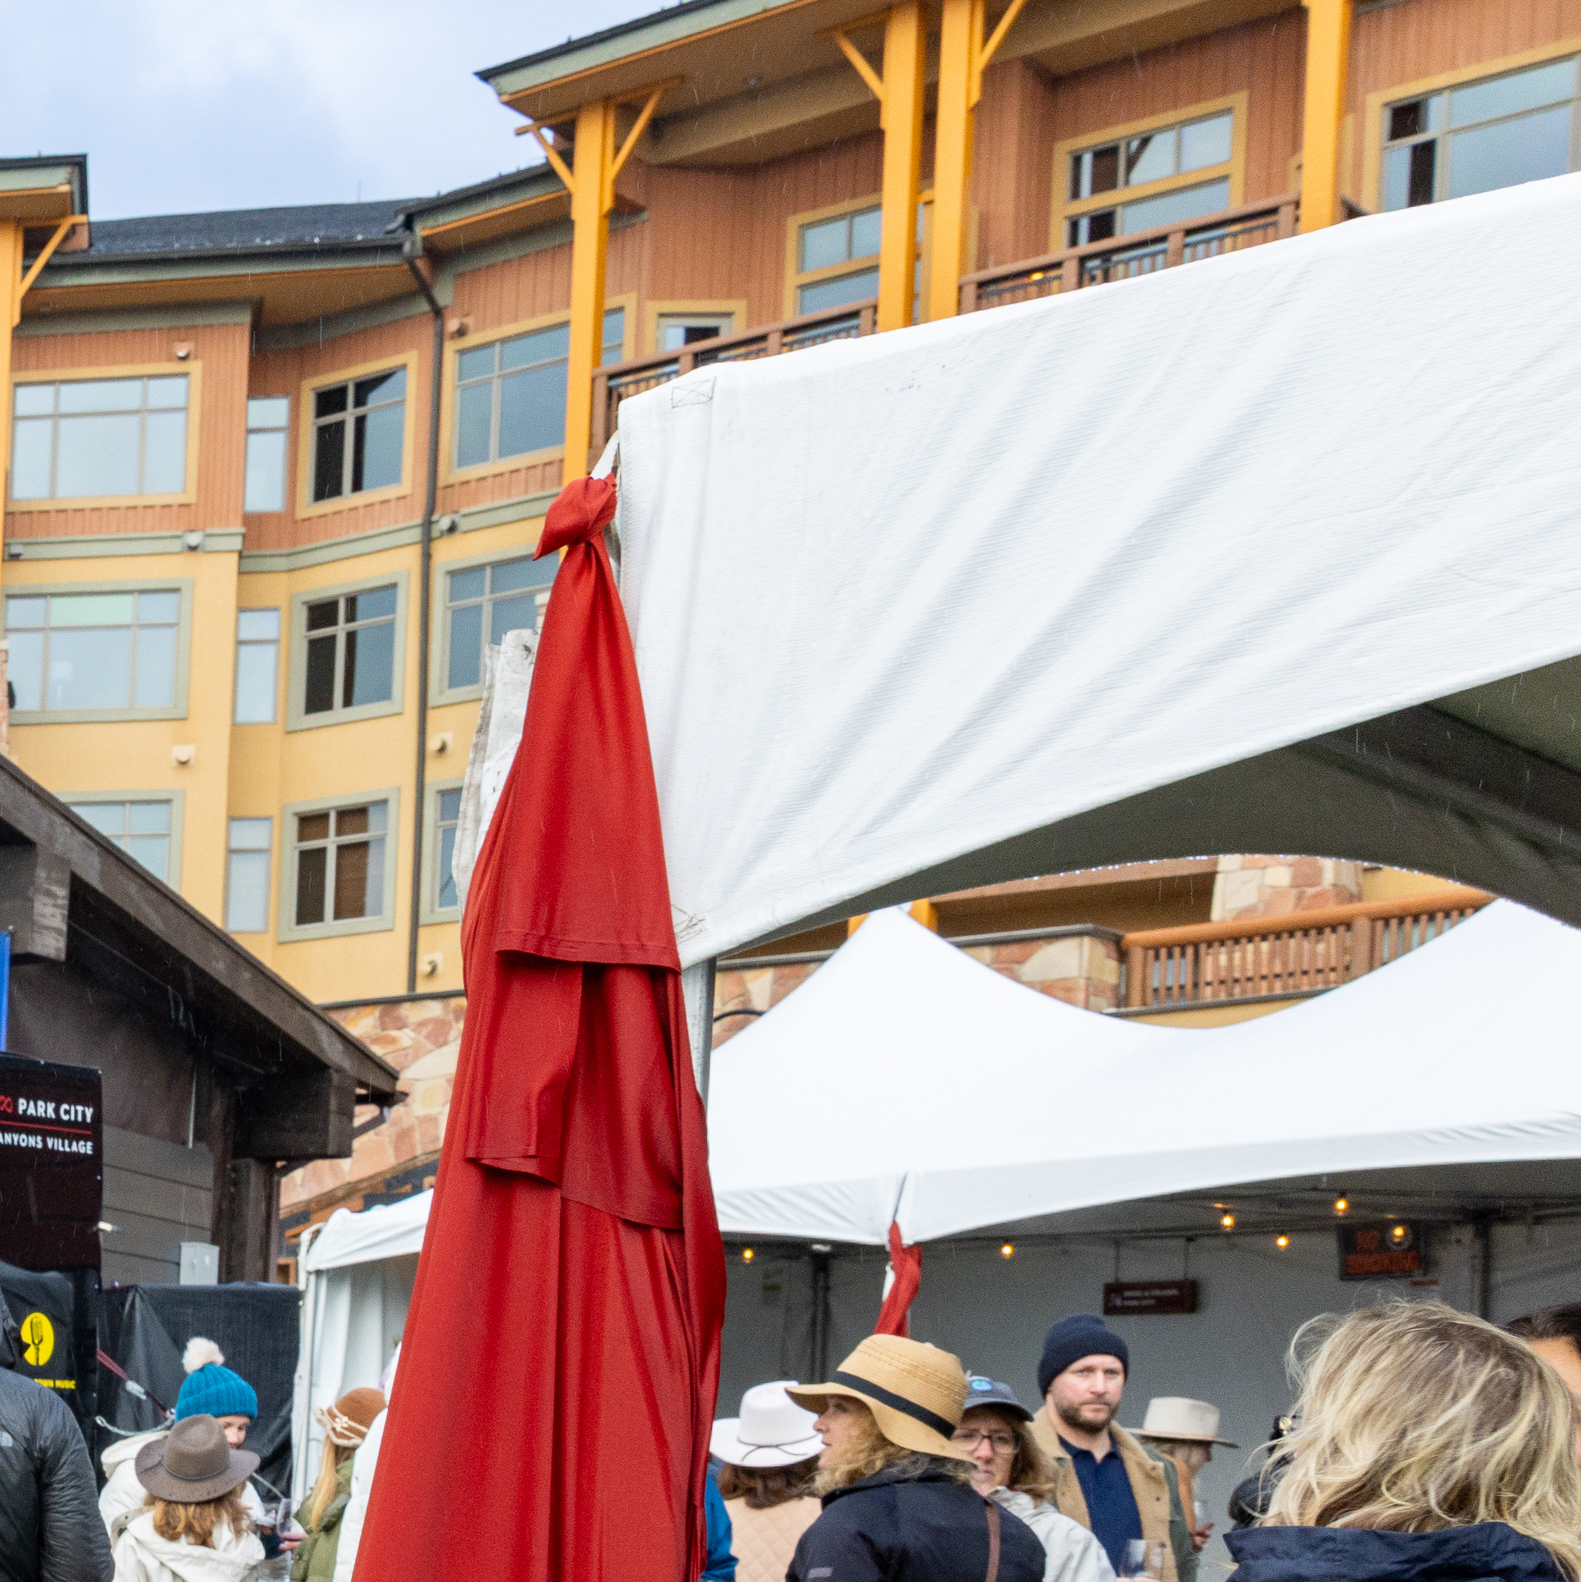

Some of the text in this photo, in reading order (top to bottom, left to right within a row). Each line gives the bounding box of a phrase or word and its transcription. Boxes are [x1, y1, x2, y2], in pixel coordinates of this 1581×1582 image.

[18, 1097, 93, 1123] PARK CITY
[46, 1136, 93, 1155] VILLAGE
